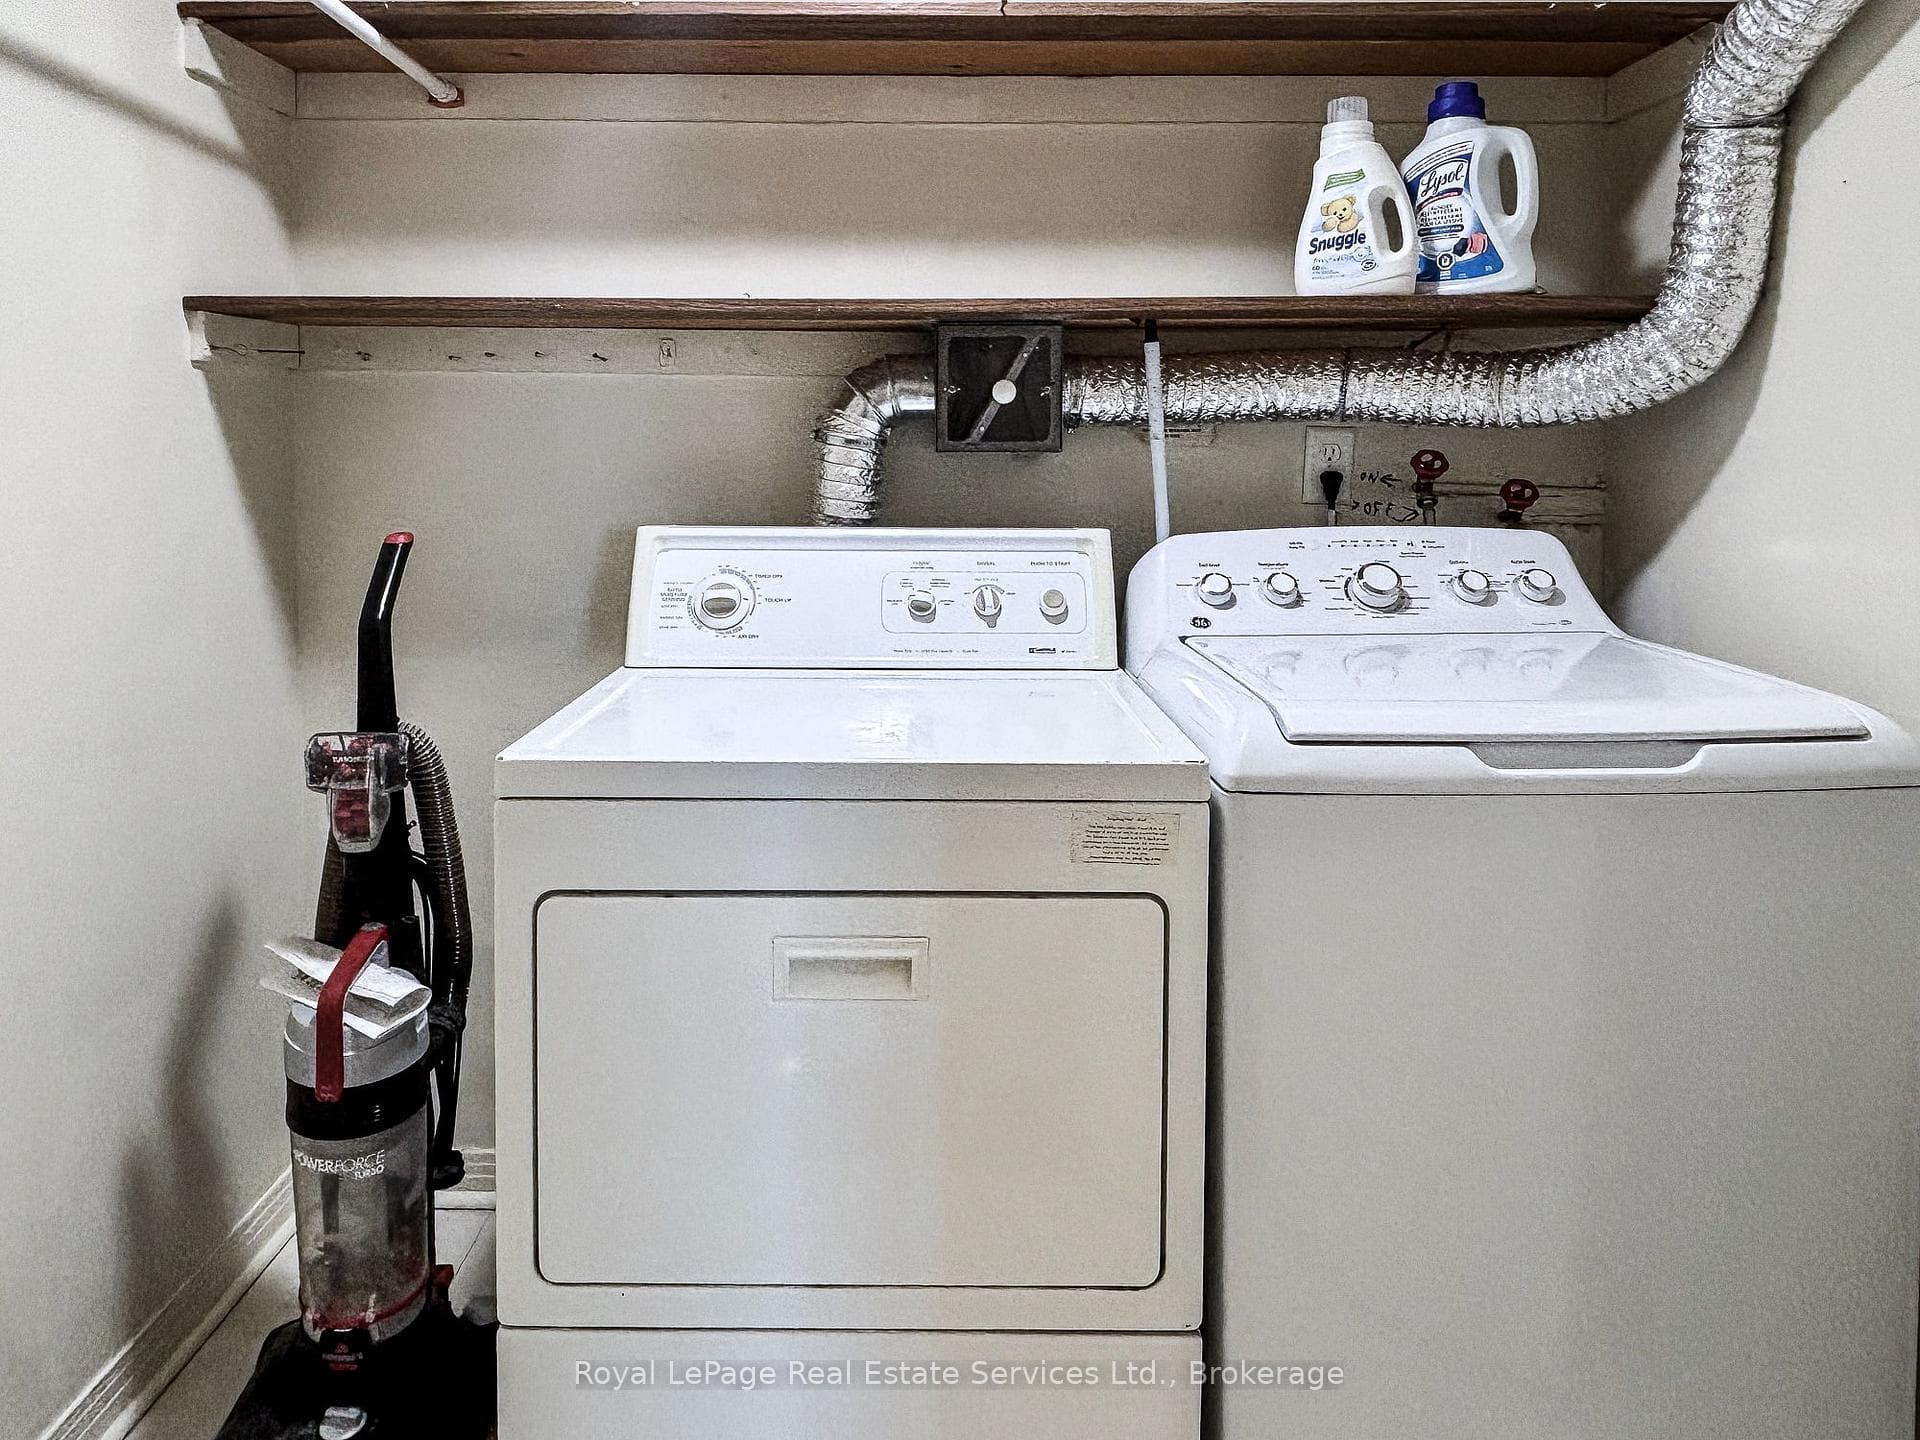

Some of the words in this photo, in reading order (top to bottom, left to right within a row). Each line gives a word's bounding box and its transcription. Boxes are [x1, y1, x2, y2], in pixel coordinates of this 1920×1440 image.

[1420, 162, 1465, 198] Lysol
[1308, 229, 1367, 255] Snuggle
[1360, 471, 1380, 483] ON
[1363, 501, 1397, 517] OFF
